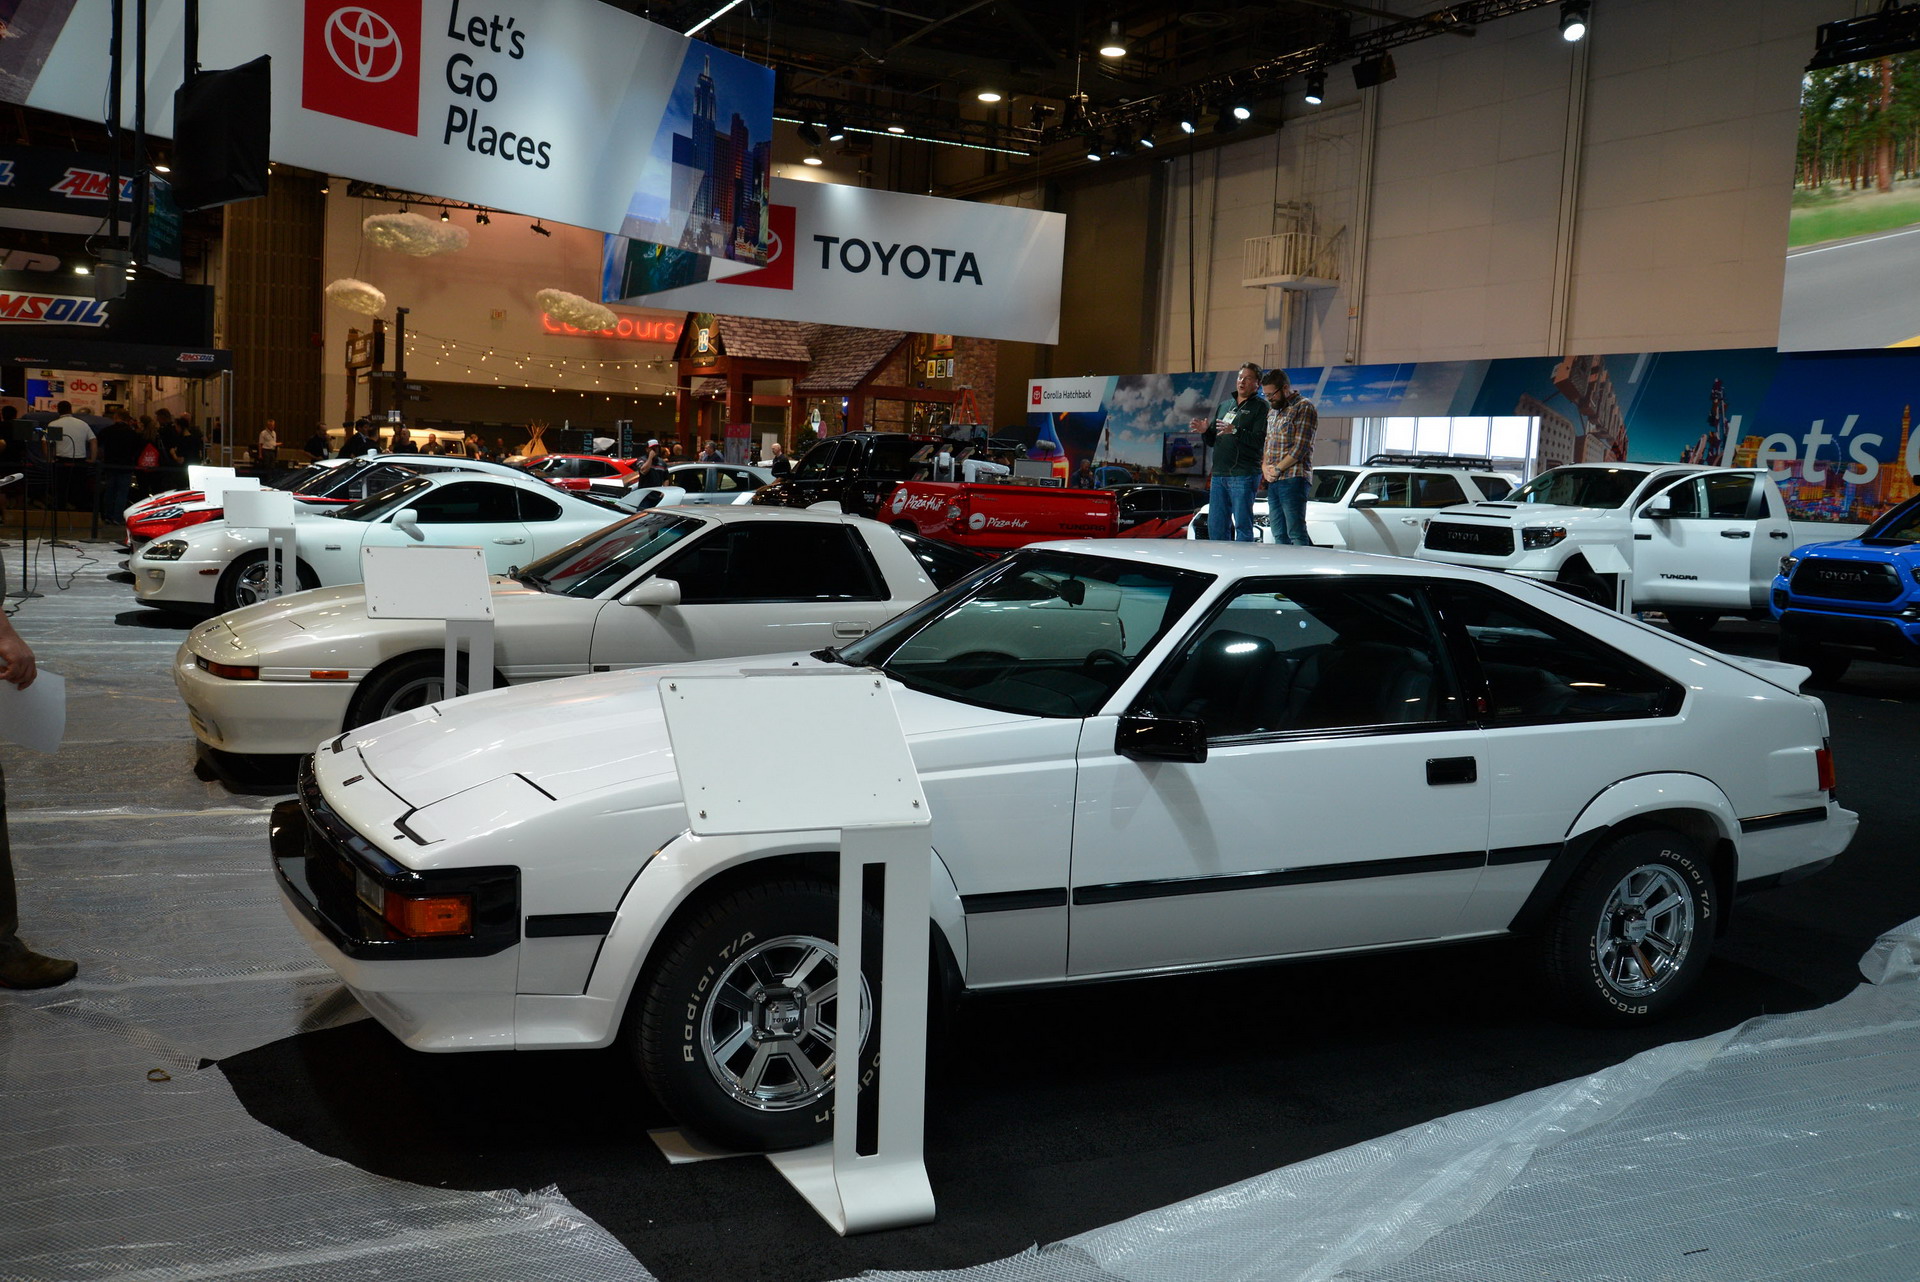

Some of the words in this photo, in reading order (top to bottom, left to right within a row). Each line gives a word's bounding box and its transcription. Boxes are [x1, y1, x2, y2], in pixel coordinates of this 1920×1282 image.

[447, 0, 526, 60] Let's
[446, 53, 498, 103] Go
[443, 104, 552, 170] Places
[813, 234, 984, 286] TOYOTA
[0, 292, 107, 325] MSOIL
[176, 352, 215, 363] AMSOIL
[70, 378, 98, 393] dba
[1043, 390, 1062, 400] Corolla
[1063, 389, 1092, 399] Hatchback
[1721, 415, 1884, 485] Let's
[904, 494, 926, 510] Pizza
[925, 496, 945, 511] Hut
[987, 517, 1011, 528] Pizza
[1011, 519, 1029, 528] Hut
[1058, 522, 1106, 532] TUNDRA
[1447, 531, 1480, 542] TOYOTA
[1660, 573, 1698, 581] TUNDRA
[1819, 570, 1862, 582] TOYOTA
[1659, 849, 1704, 886] Radial
[1700, 889, 1711, 919] T/A
[1589, 935, 1648, 1014] BFGoodrich
[683, 966, 715, 1062] Radial
[718, 931, 756, 960] T/A
[772, 1016, 798, 1024] TOYOTA
